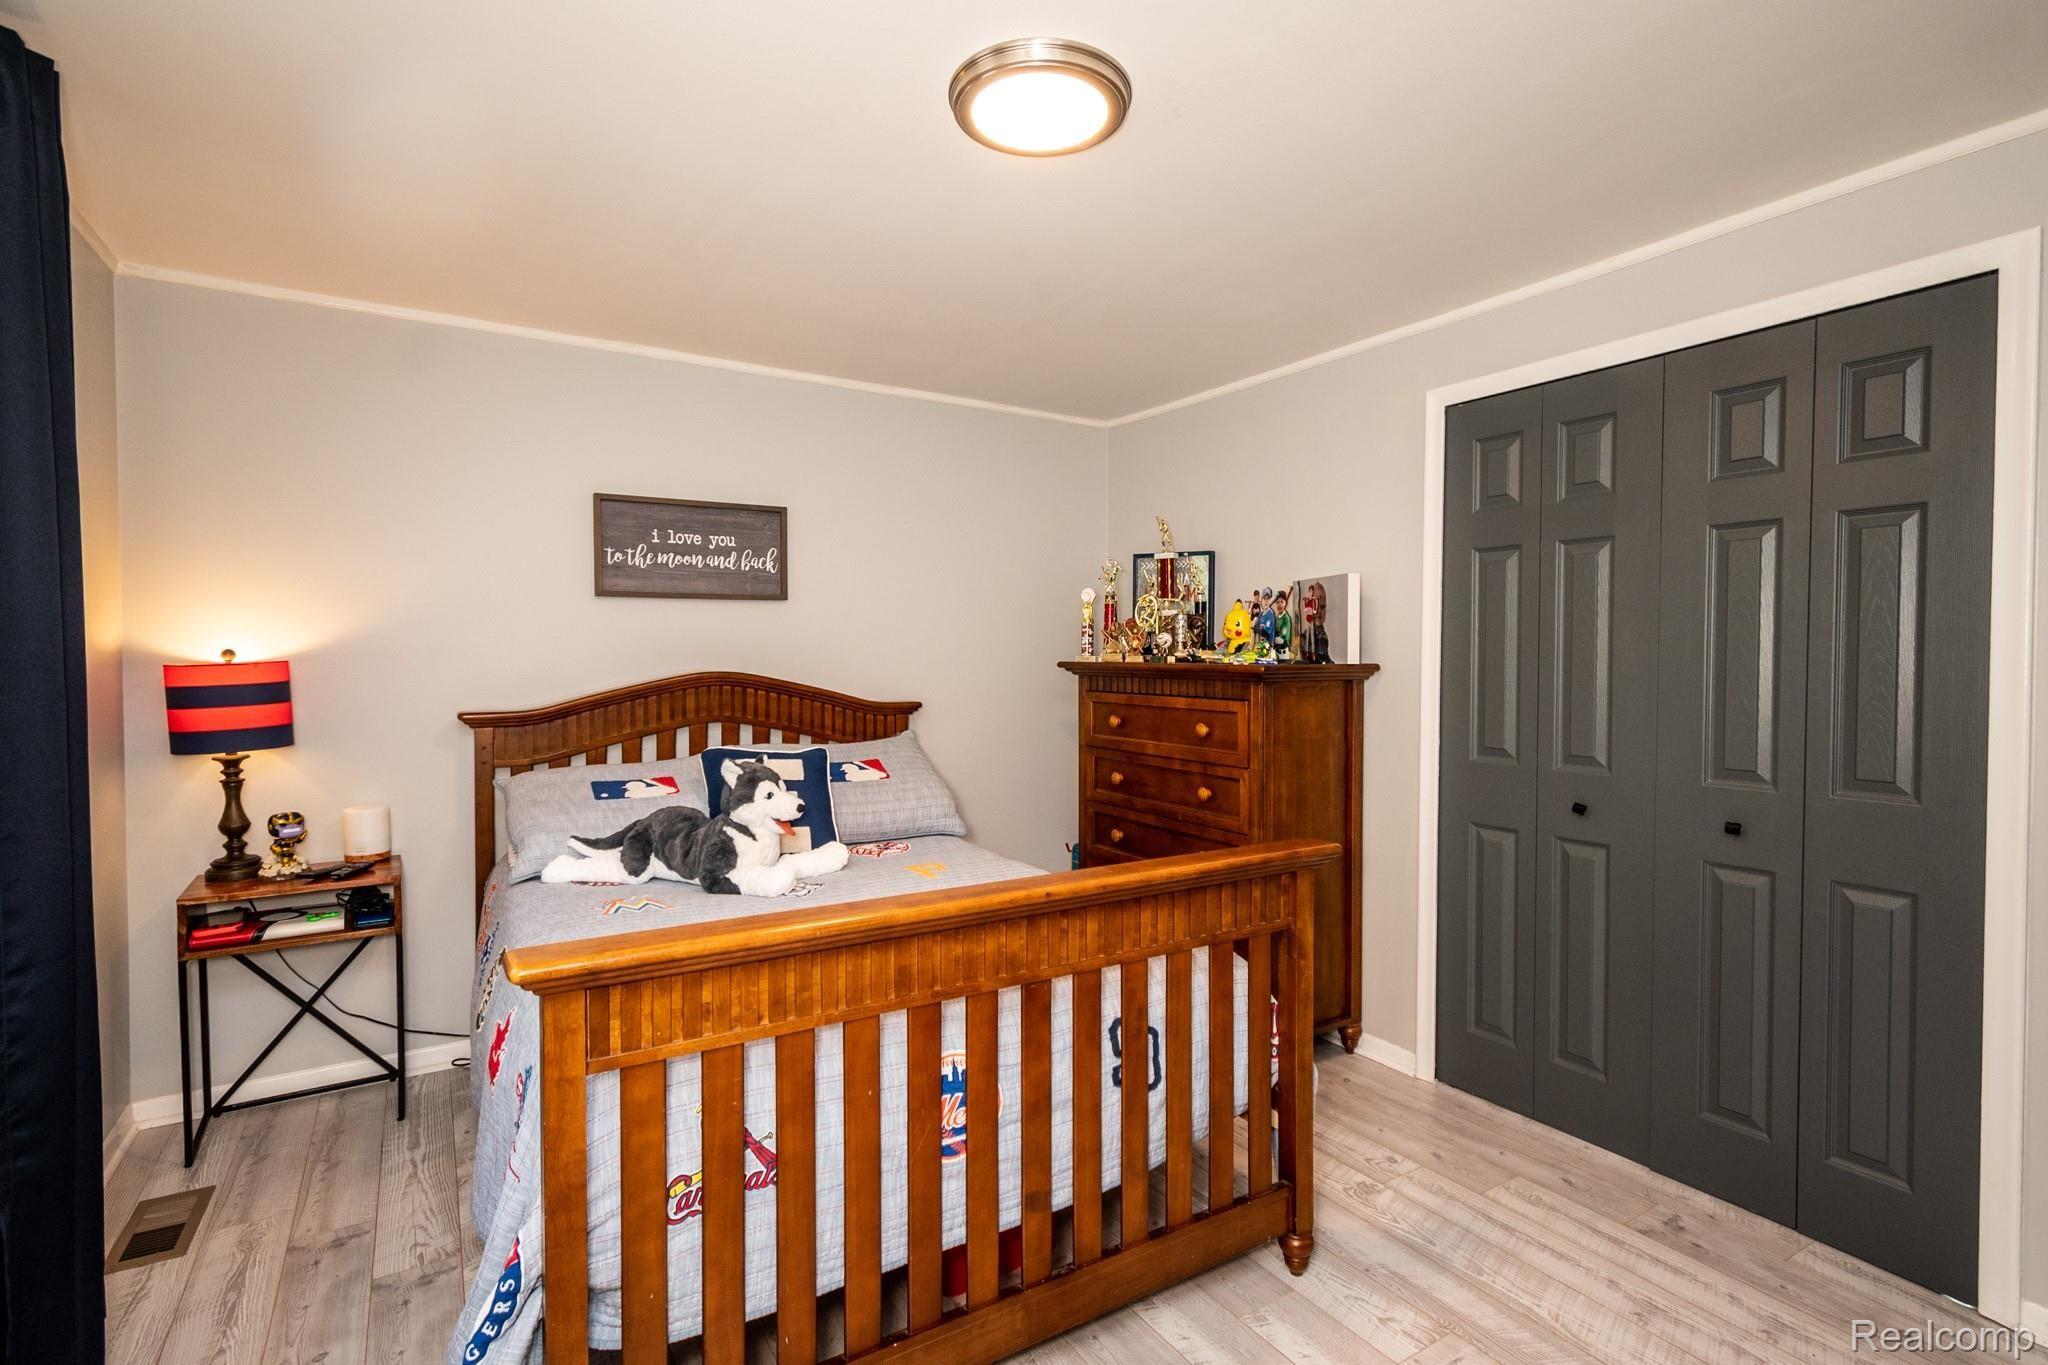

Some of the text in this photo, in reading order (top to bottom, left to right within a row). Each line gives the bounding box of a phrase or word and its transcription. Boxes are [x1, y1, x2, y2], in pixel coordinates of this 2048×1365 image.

[651, 529, 736, 549] i love you
[604, 544, 779, 573] to the moon and back
